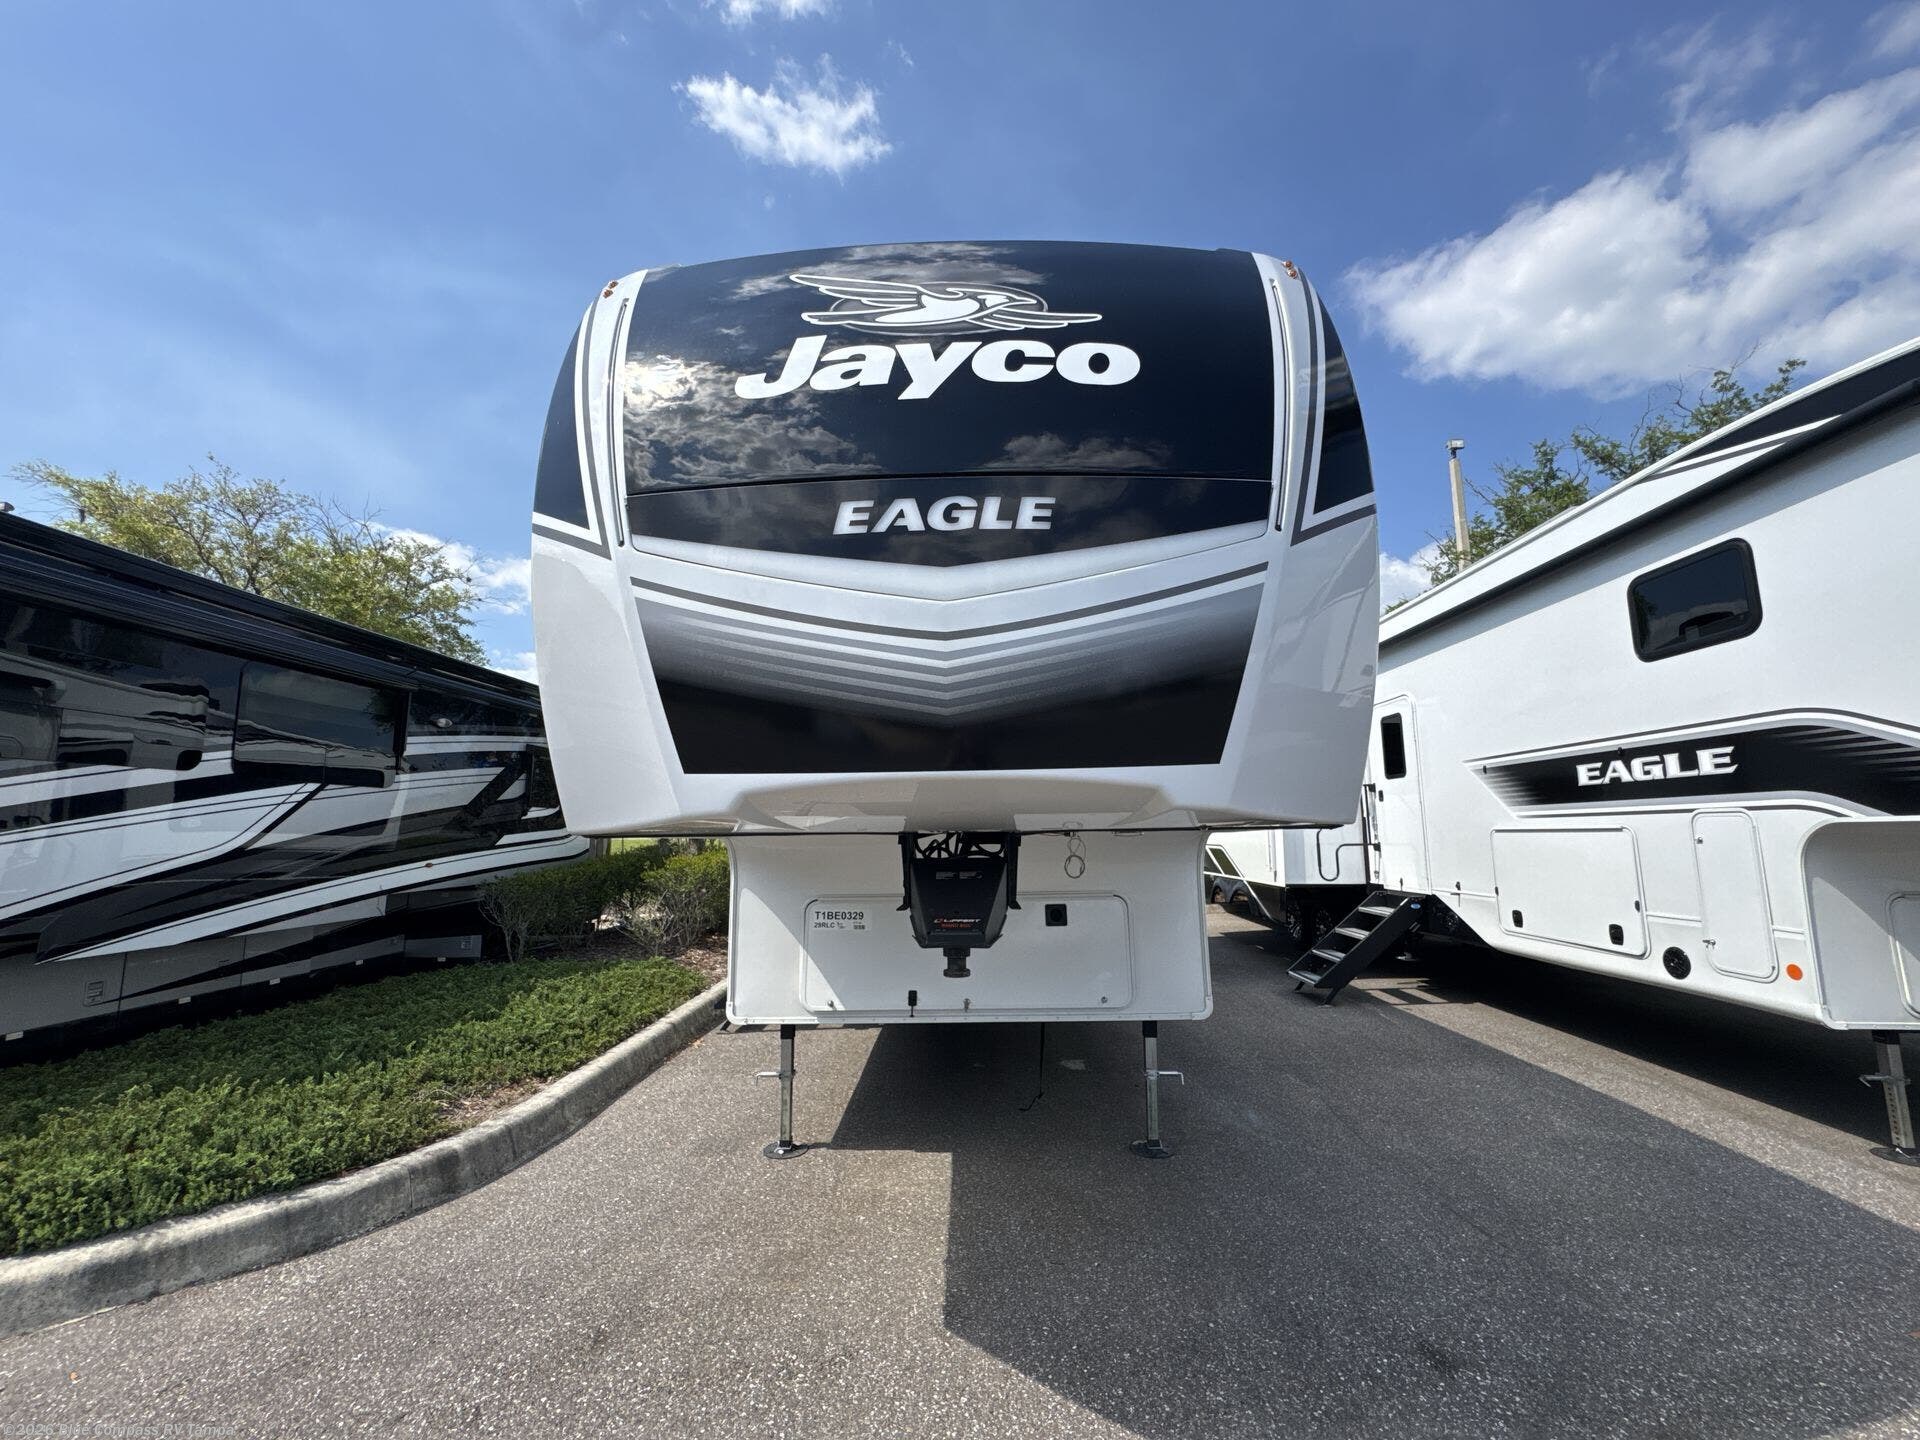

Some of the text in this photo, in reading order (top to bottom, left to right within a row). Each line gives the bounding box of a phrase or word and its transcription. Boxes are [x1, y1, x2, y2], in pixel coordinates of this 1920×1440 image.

[735, 334, 1141, 401] Jayco
[832, 495, 1057, 536] EAGLE
[1575, 745, 1739, 787] EAGLE
[814, 911, 865, 921] T1BE0329
